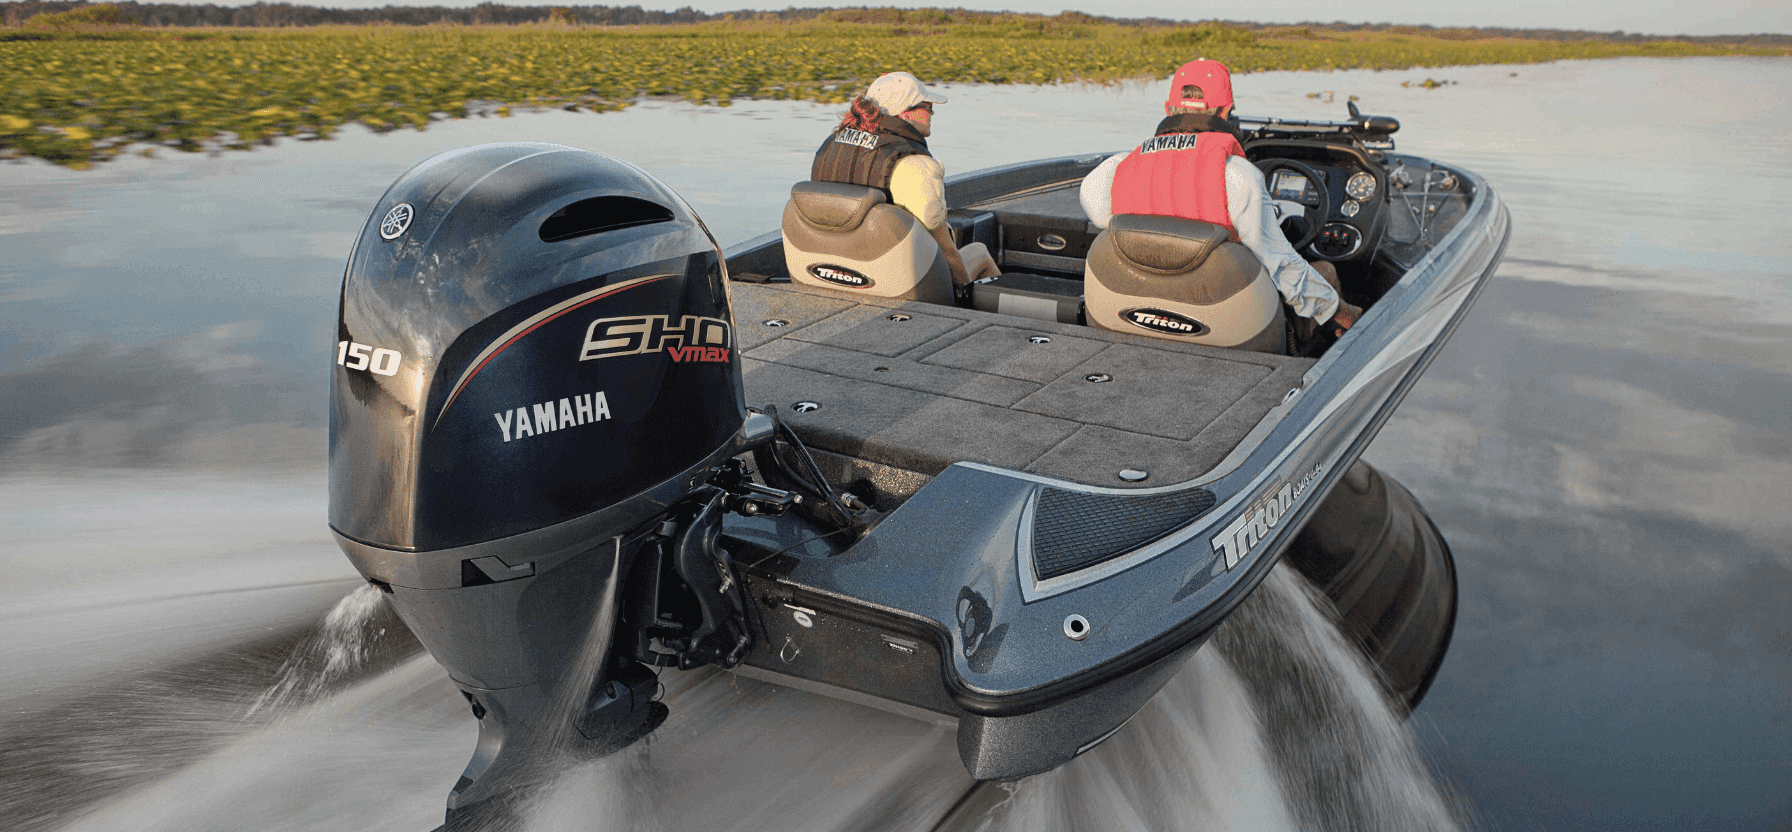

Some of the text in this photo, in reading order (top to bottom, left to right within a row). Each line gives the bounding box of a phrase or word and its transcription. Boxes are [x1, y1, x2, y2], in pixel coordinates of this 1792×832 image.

[1140, 133, 1198, 155] YAMAHA
[817, 267, 863, 284] Triton
[579, 315, 731, 361] SHO
[1133, 312, 1193, 332] Triton
[337, 341, 402, 377] 150
[493, 391, 612, 443] YAMAHA
[1209, 482, 1293, 574] Triton
